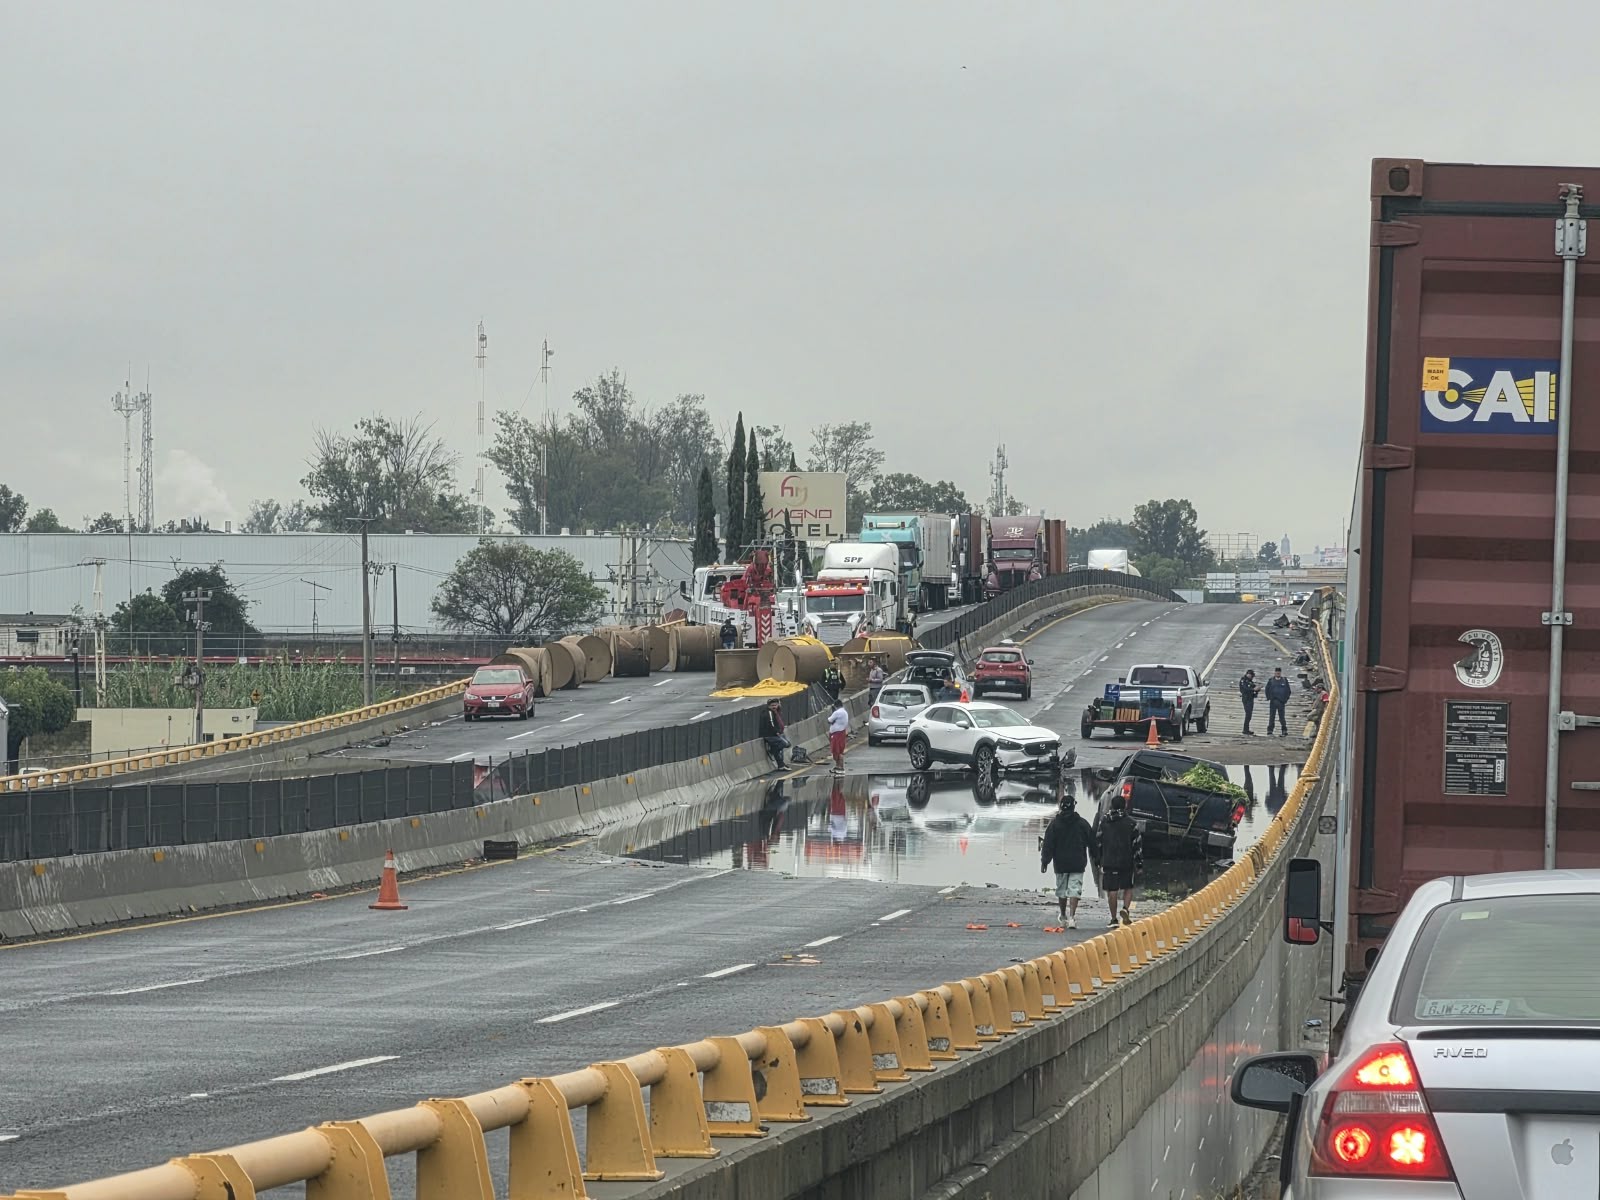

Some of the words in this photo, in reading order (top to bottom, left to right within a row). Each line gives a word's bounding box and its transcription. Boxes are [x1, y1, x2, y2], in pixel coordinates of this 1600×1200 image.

[1424, 369, 1550, 422] CAI
[769, 523, 838, 537] OTEL
[1433, 1047, 1488, 1058] AVEO
